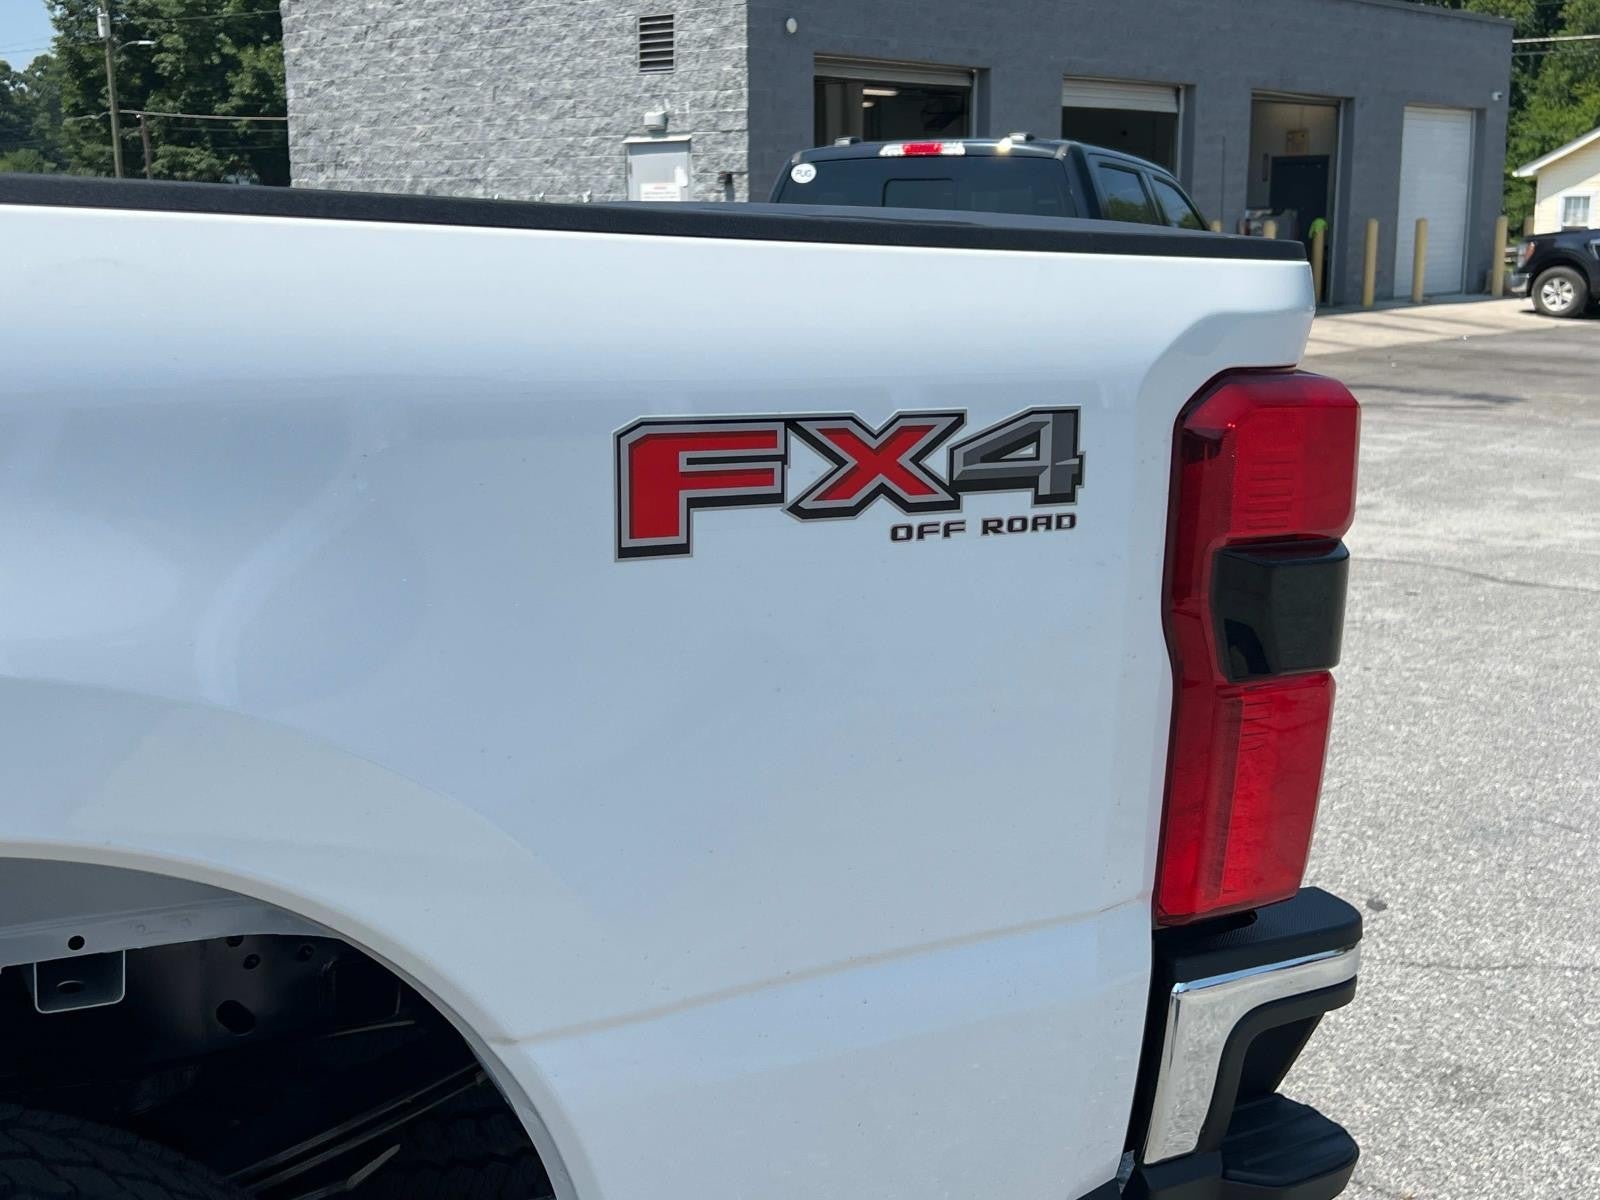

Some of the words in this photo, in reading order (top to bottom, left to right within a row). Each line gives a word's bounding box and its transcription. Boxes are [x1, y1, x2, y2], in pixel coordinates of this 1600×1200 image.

[613, 405, 1086, 562] FX4
[890, 520, 966, 542] OFF
[980, 512, 1077, 536] ROAD
